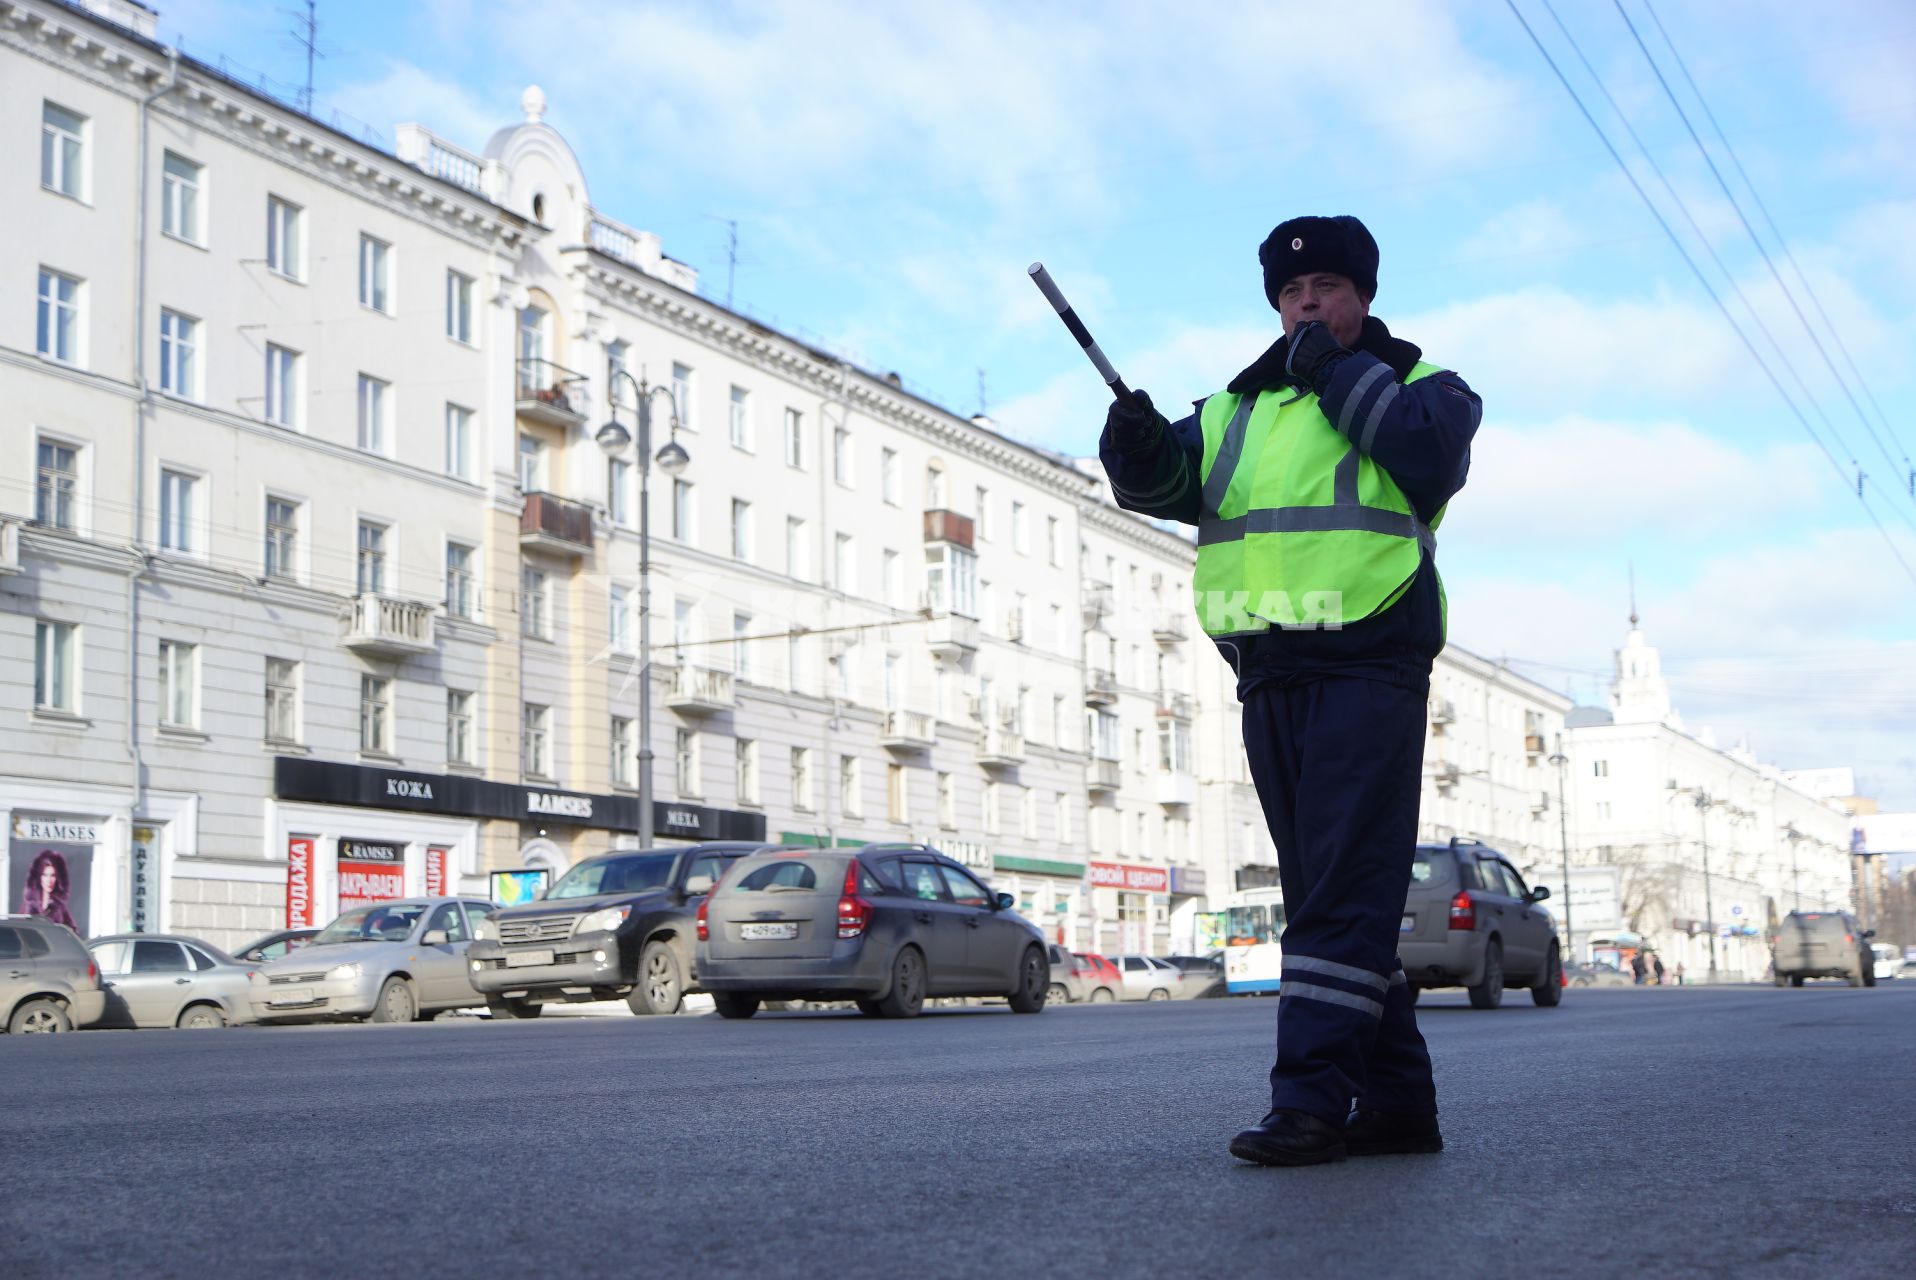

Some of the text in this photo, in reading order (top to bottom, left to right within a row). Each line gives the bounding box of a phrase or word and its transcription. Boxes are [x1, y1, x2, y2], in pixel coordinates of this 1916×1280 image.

[386, 779, 434, 799] КОЖА
[527, 792, 593, 818] RAMSES
[31, 824, 96, 840] RAMSES
[352, 843, 395, 860] RAMSES
